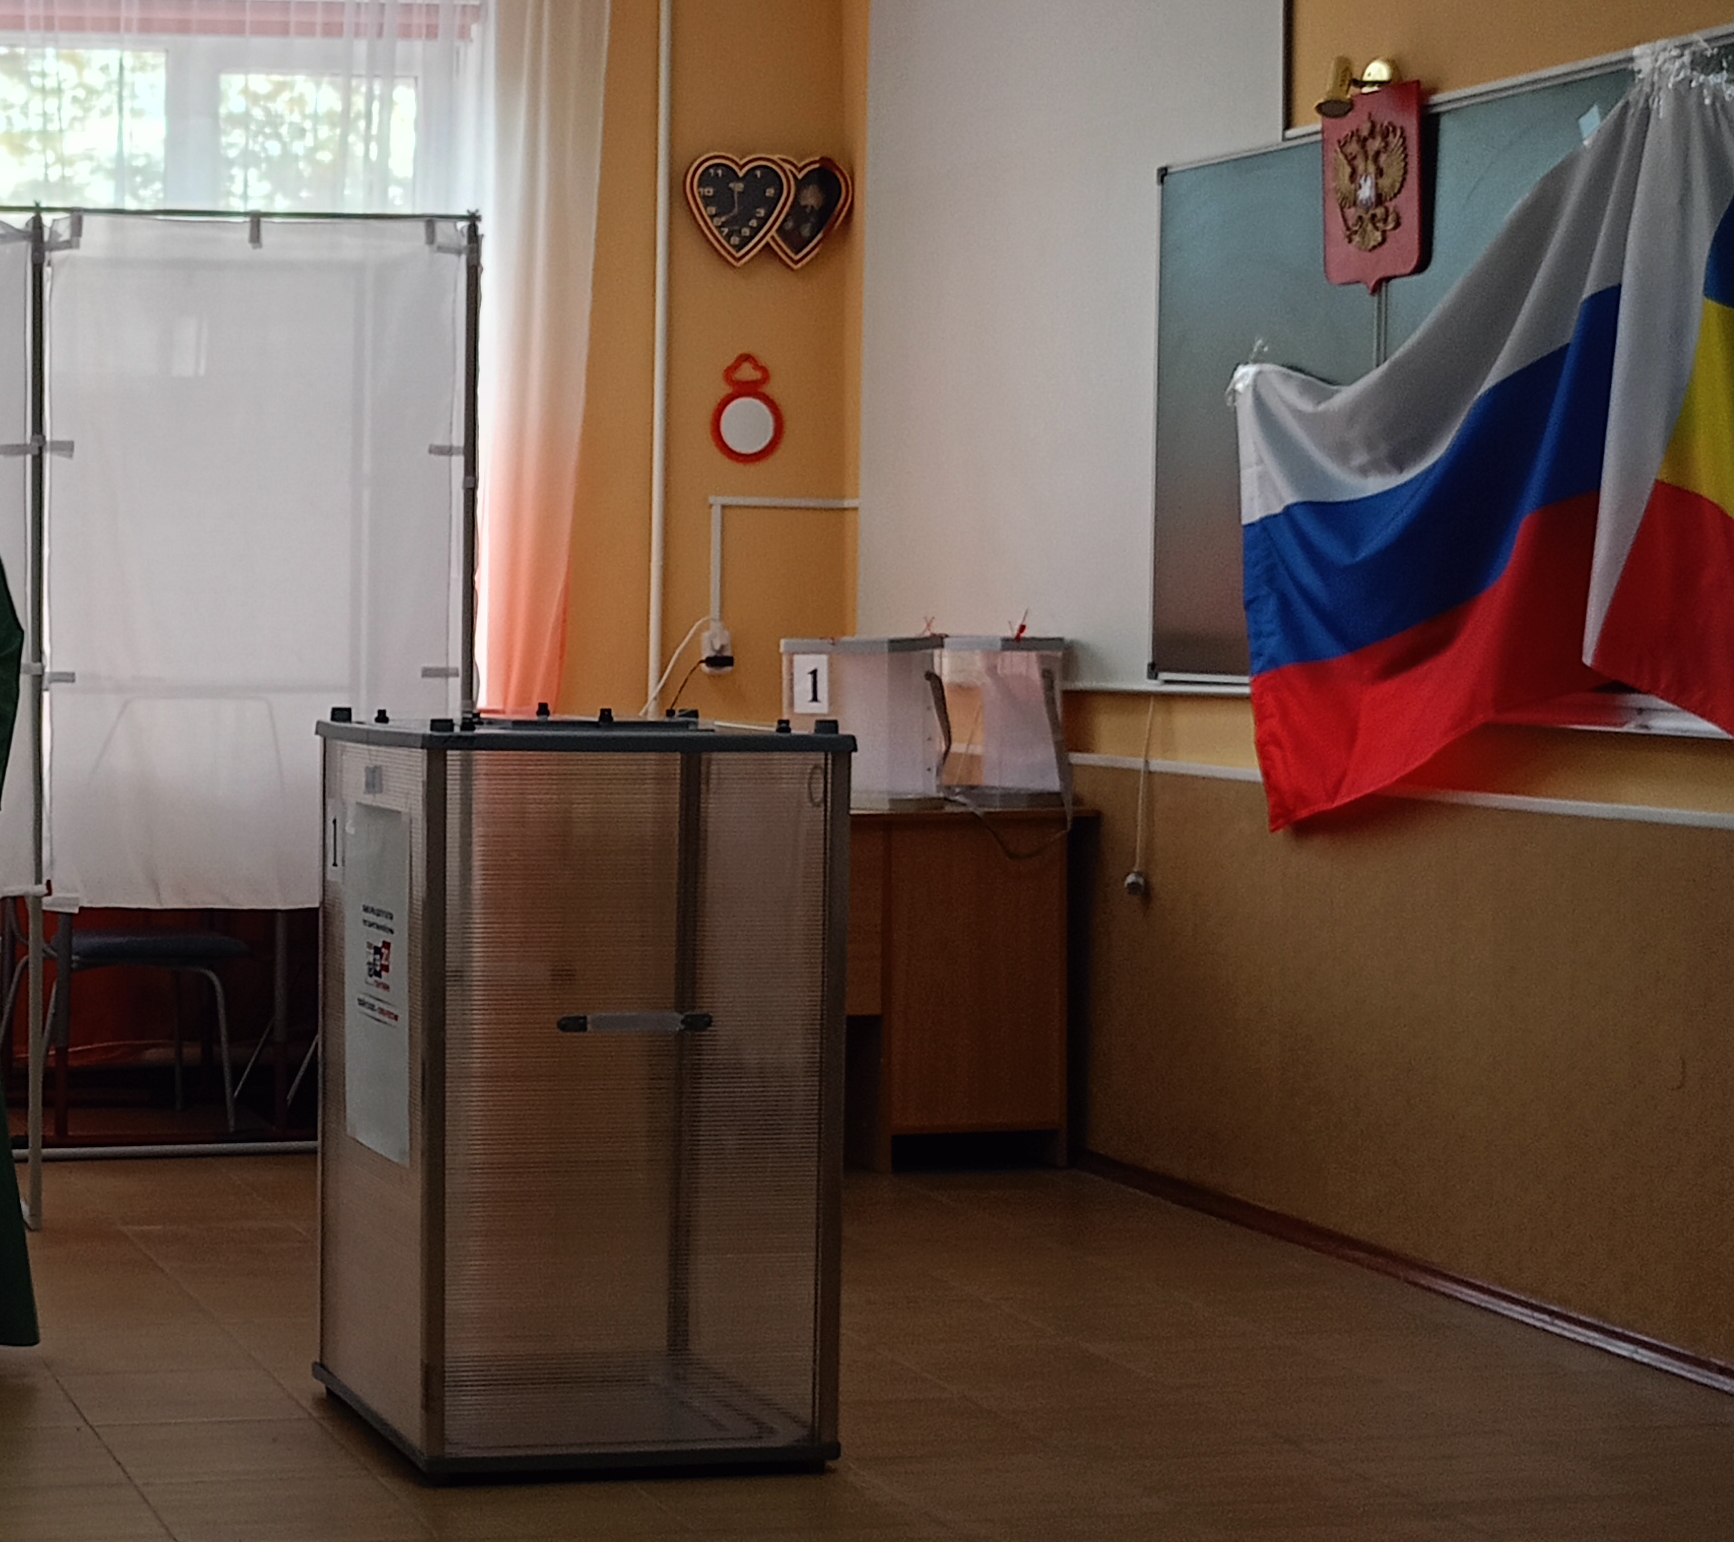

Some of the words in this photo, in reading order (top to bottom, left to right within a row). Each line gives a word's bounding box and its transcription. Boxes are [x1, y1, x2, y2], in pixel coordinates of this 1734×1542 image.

[709, 169, 723, 178] 11
[754, 169, 762, 178] 1
[698, 187, 713, 197] 10
[755, 208, 765, 217] 3
[748, 219, 758, 228] 4
[721, 227, 729, 236] 7
[807, 667, 822, 703] 1
